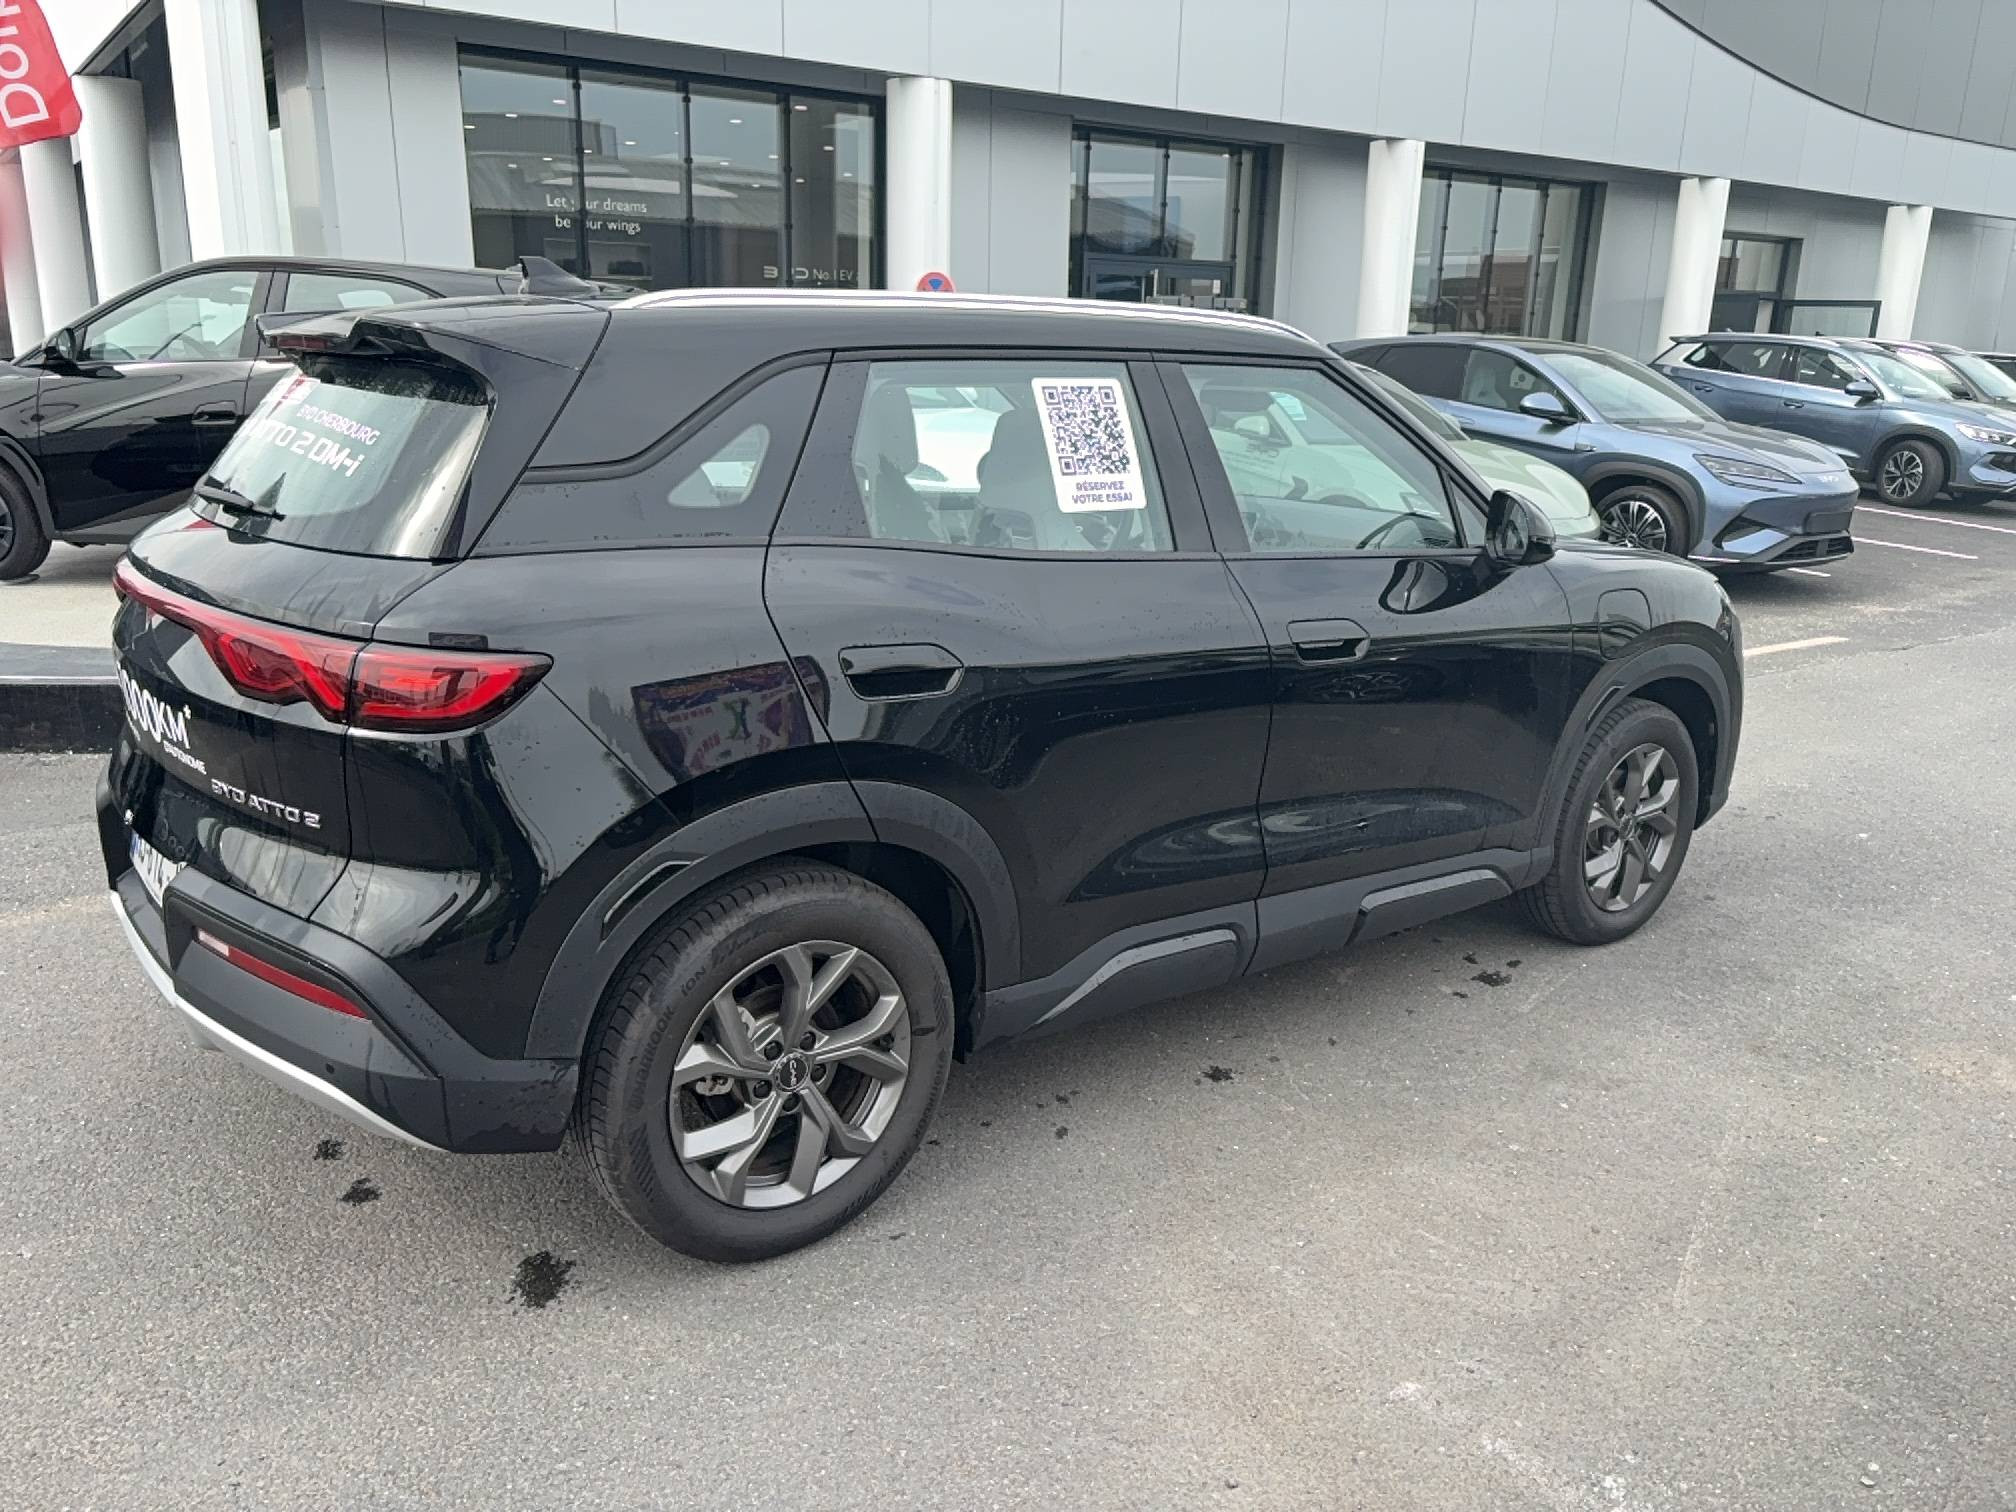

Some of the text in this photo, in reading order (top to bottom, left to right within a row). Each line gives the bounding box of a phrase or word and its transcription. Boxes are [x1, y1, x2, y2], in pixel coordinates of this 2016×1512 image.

[546, 193, 567, 208] Let
[603, 197, 647, 213] dreams
[555, 214, 571, 229] be
[606, 219, 641, 235] wings
[763, 265, 809, 280] BD
[314, 409, 381, 446] CHERBOURG
[289, 431, 316, 454] 2
[307, 437, 365, 477] DM-i
[1071, 491, 1133, 504] VOTRE ESSAI
[211, 778, 321, 829] BYD ATTO 2
